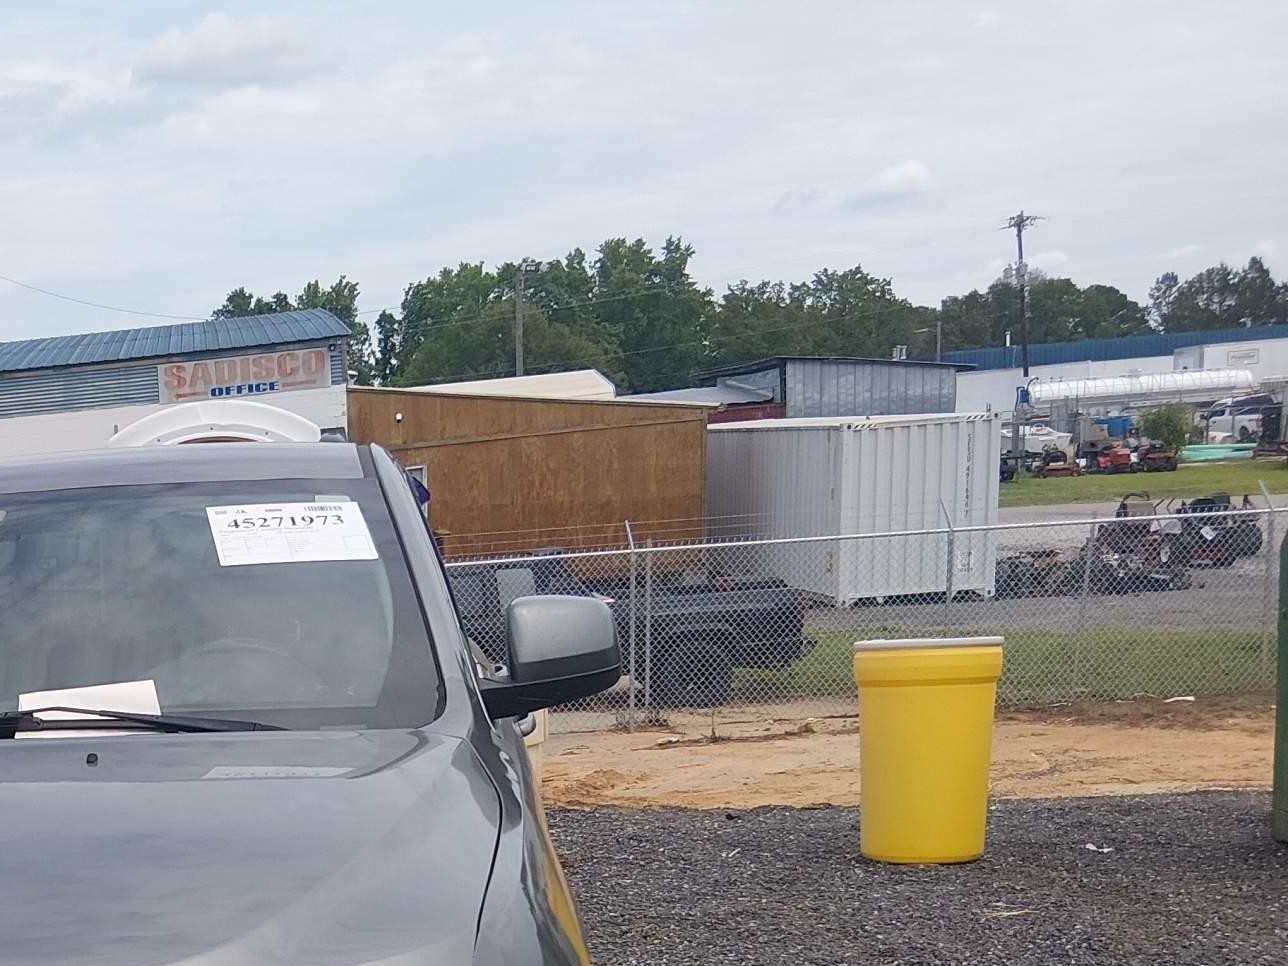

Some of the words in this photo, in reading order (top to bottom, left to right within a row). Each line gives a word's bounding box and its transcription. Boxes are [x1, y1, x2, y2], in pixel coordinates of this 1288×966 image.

[163, 350, 325, 389] SADISCO
[210, 380, 280, 397] OFFICE
[227, 514, 344, 529] 45271973
